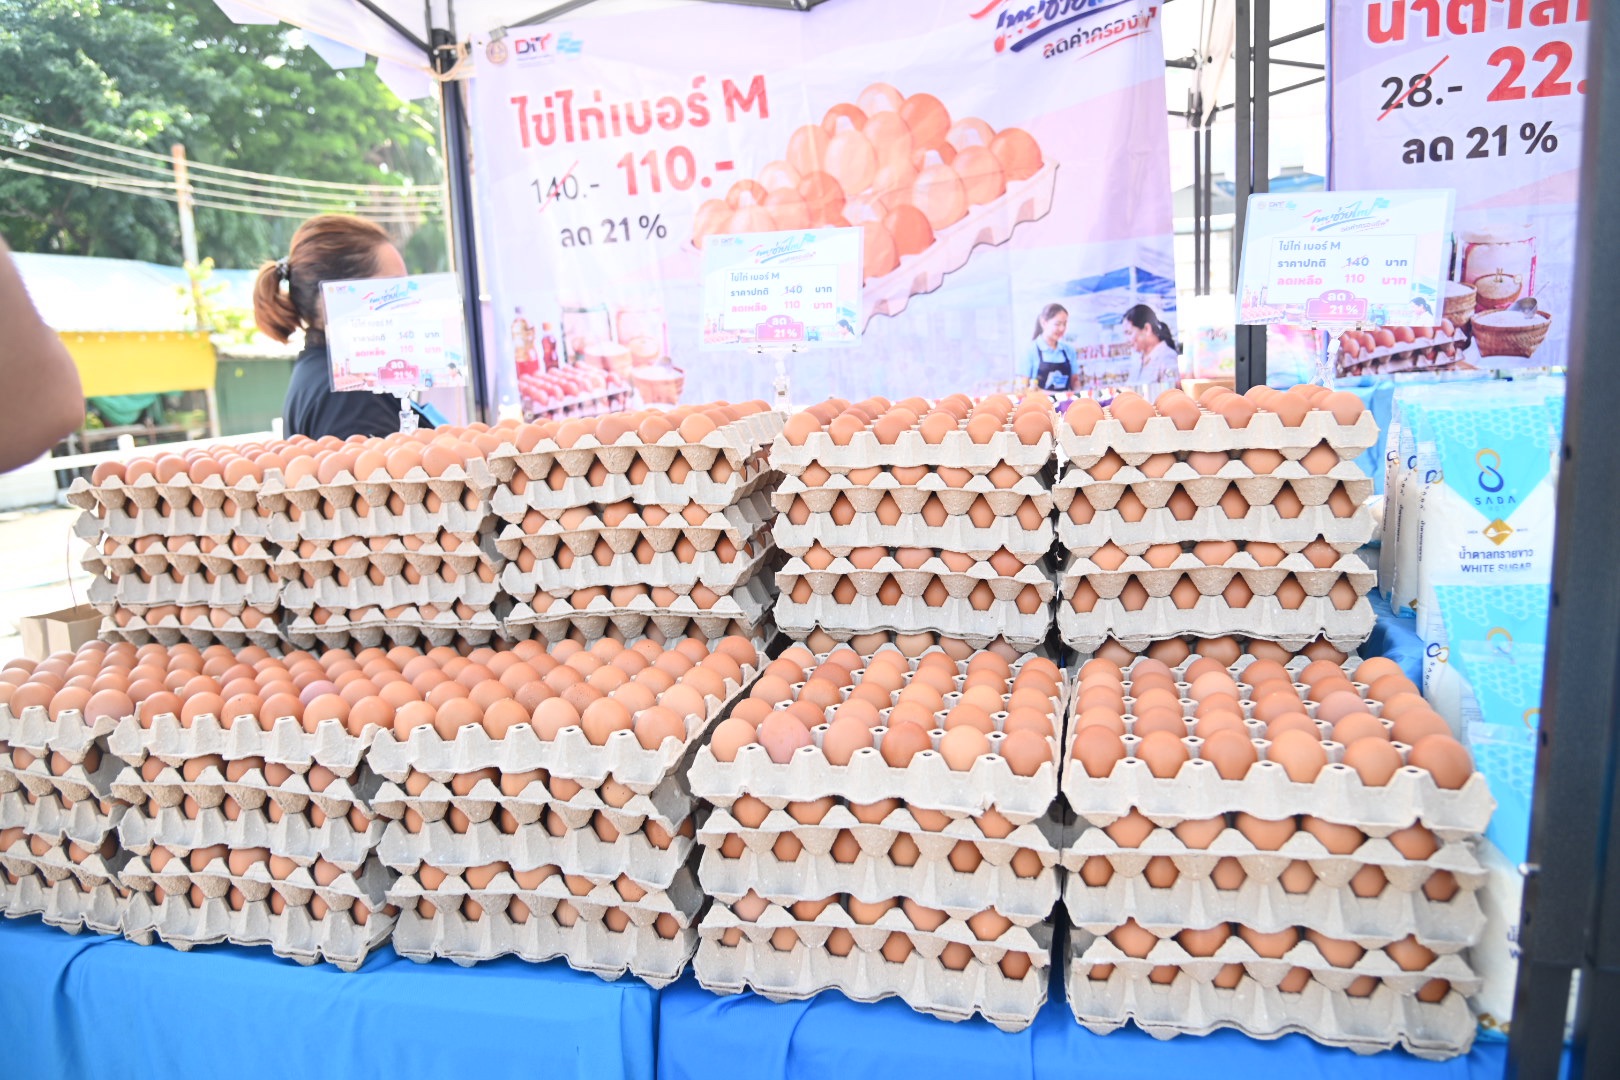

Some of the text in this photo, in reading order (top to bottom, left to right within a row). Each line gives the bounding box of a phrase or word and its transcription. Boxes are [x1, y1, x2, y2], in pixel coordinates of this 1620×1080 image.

[1367, 0, 1590, 44] นำตาล
[510, 75, 770, 148] ไข่ไก่เบอร์ M
[1402, 136, 1454, 165] ลด
[617, 145, 734, 196] 110.-
[560, 226, 592, 248] ลด
[1278, 240, 1341, 251] ไข่ไก่ เบอร์ M
[1277, 257, 1408, 268] ราคาปกติ 140 บาท
[771, 272, 780, 280] M
[1277, 274, 1407, 286] ลดเหลือ 110 บาท
[730, 287, 769, 297] ราคาปกติ
[784, 285, 803, 294] 140
[1327, 292, 1346, 301] ลด
[731, 300, 833, 313] ลดเหลือ 110 บาท
[771, 317, 787, 326] ลด
[399, 345, 414, 353] 110
[1458, 545, 1534, 560] น้ำตาลทรายขาว
[1461, 563, 1495, 573] WHITE
